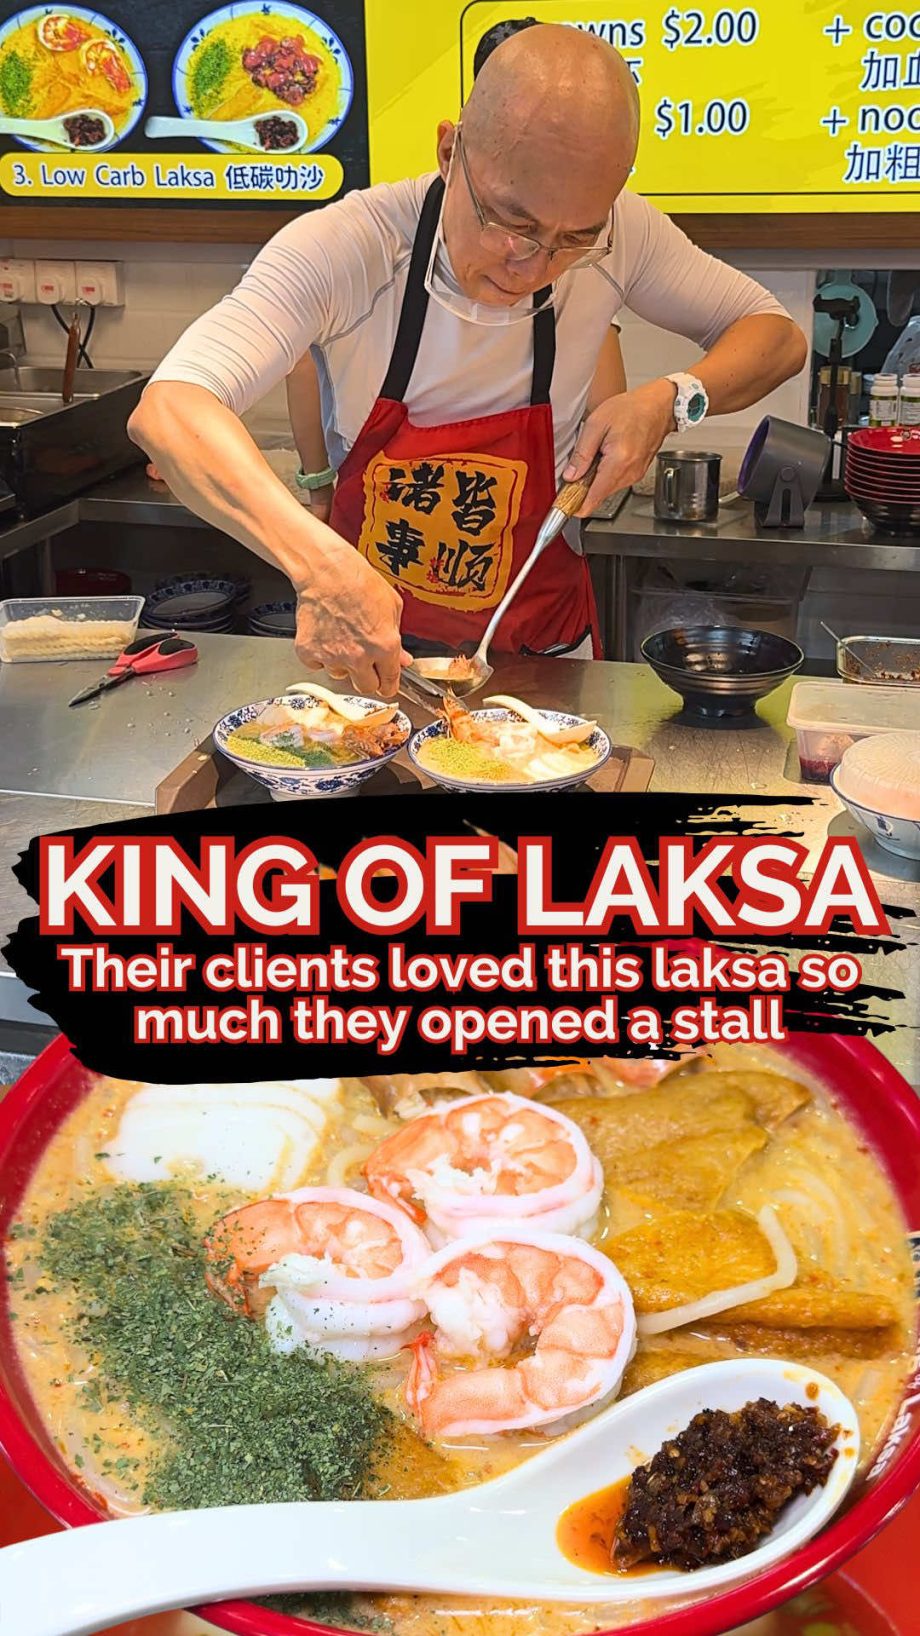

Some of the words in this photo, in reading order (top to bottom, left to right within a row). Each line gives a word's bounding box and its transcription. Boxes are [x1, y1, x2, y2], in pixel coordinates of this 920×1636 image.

[663, 9, 758, 49] $2.00
[656, 99, 748, 137] $1.00
[13, 165, 33, 186] 3.
[42, 164, 86, 186] Low
[96, 164, 145, 187] Carb
[156, 165, 215, 188] Laksa
[225, 164, 324, 191] 低碳叻沙
[844, 143, 920, 182] 加粗
[866, 1391, 920, 1481] Laksa
